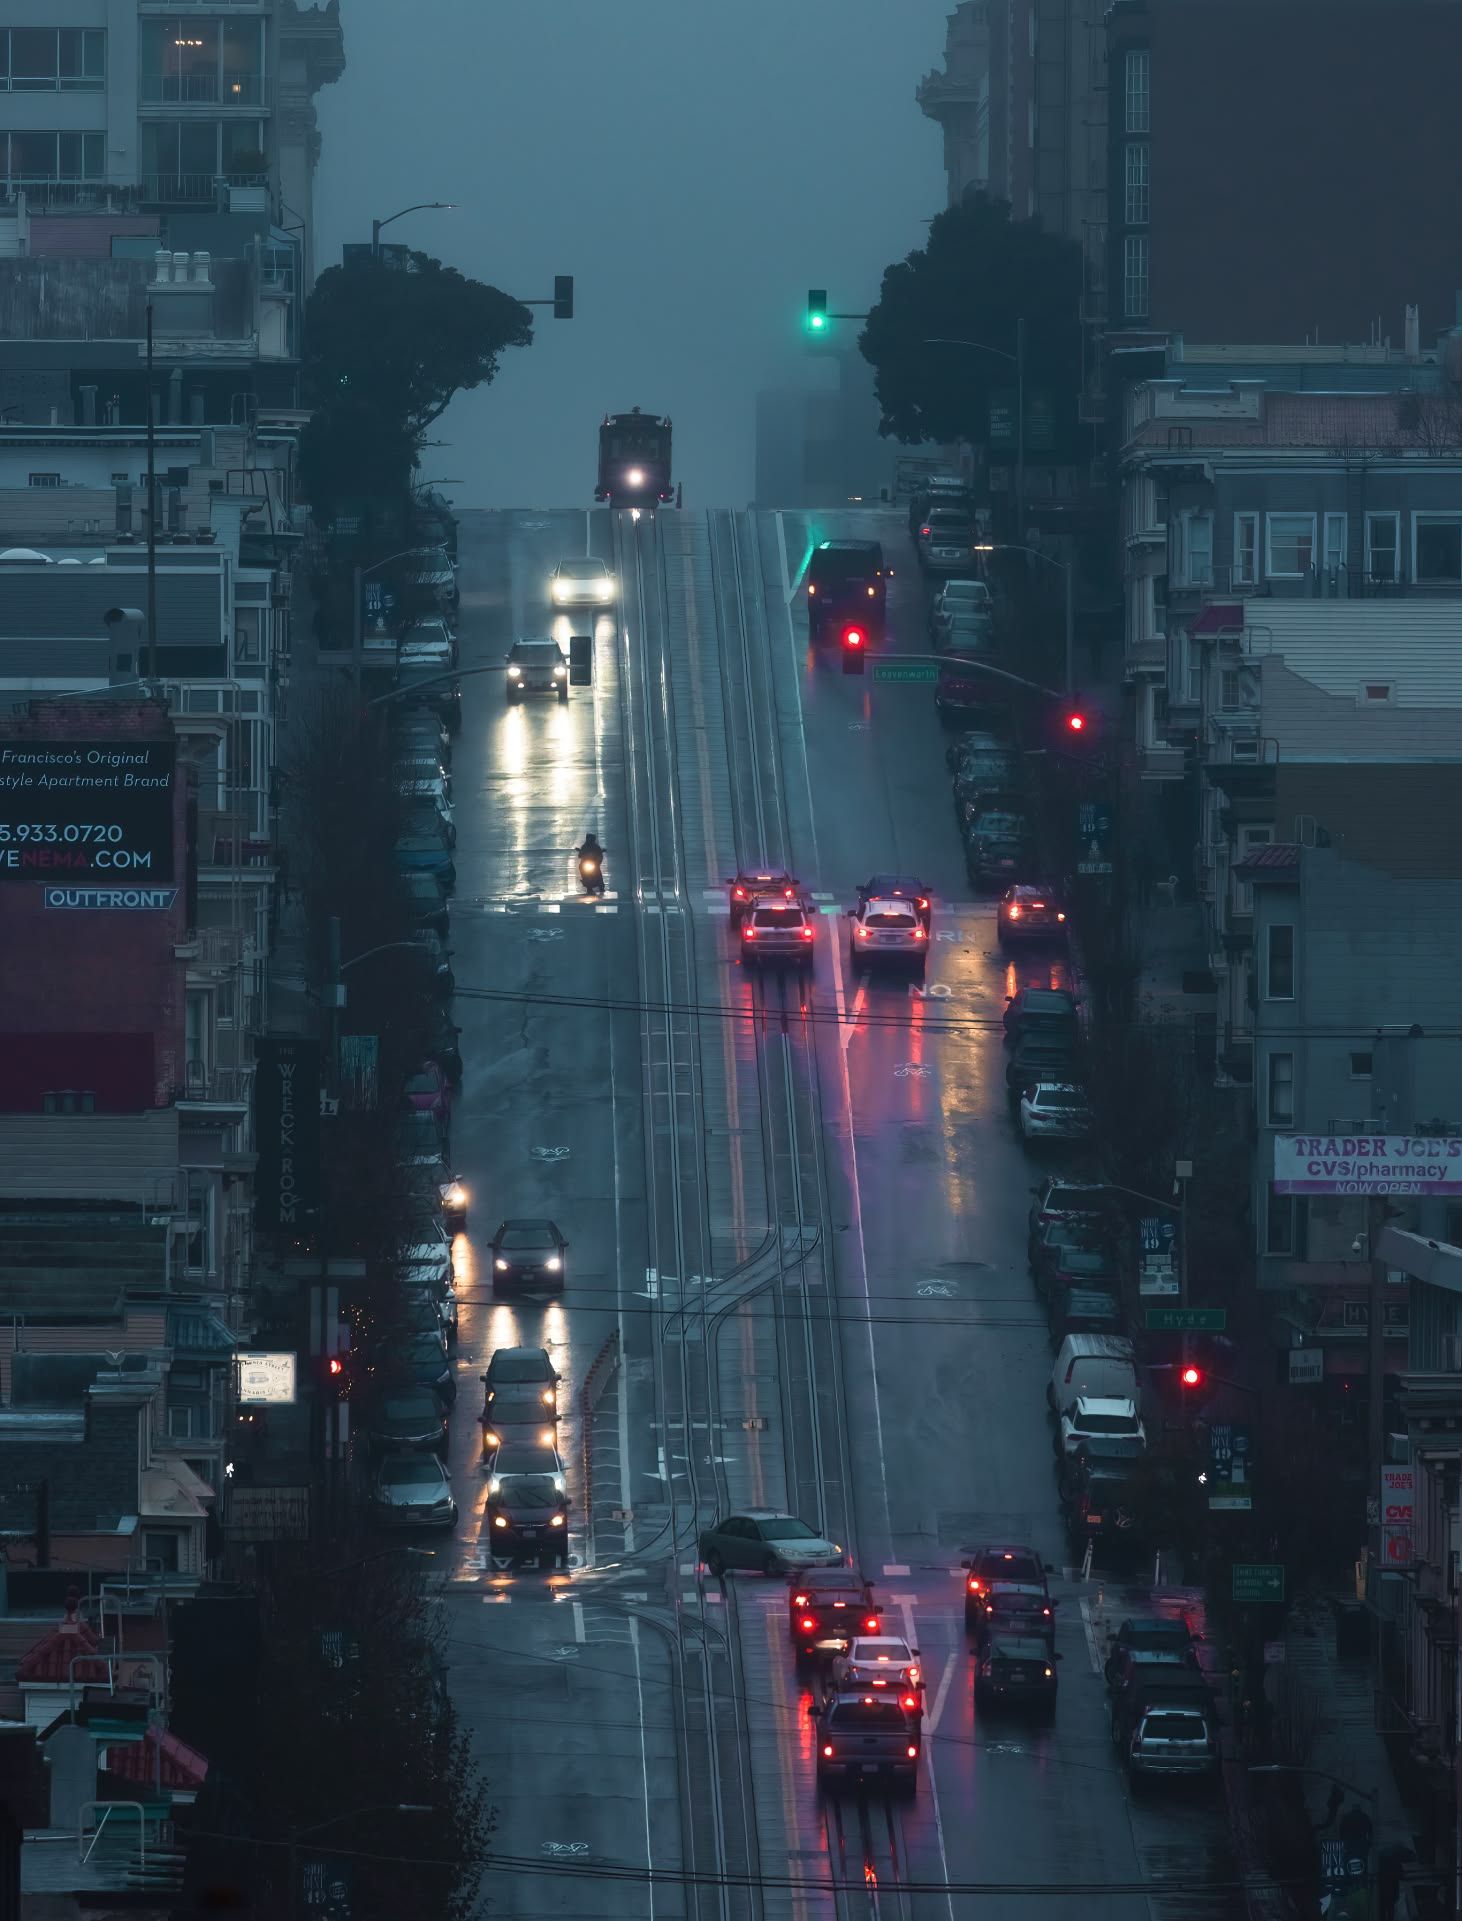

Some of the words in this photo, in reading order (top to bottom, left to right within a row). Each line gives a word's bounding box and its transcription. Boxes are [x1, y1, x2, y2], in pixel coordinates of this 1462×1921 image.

[875, 669, 936, 681] Leavenworth
[2, 750, 82, 764] Francisco's
[87, 750, 150, 767] Original
[38, 773, 119, 790] Apartment
[124, 773, 170, 787] Brand
[49, 890, 170, 907] OUTFRONT
[908, 983, 953, 998] NO
[277, 1063, 297, 1145] WRECK
[1295, 1138, 1387, 1157] TRADER
[1393, 1138, 1462, 1158] JOE'S
[1307, 1160, 1448, 1180] CVS/pharmacy
[279, 1158, 299, 1223] ROOM
[1335, 1182, 1373, 1193] NOW
[1377, 1182, 1422, 1194] OPEN
[1163, 1313, 1207, 1327] Hyde
